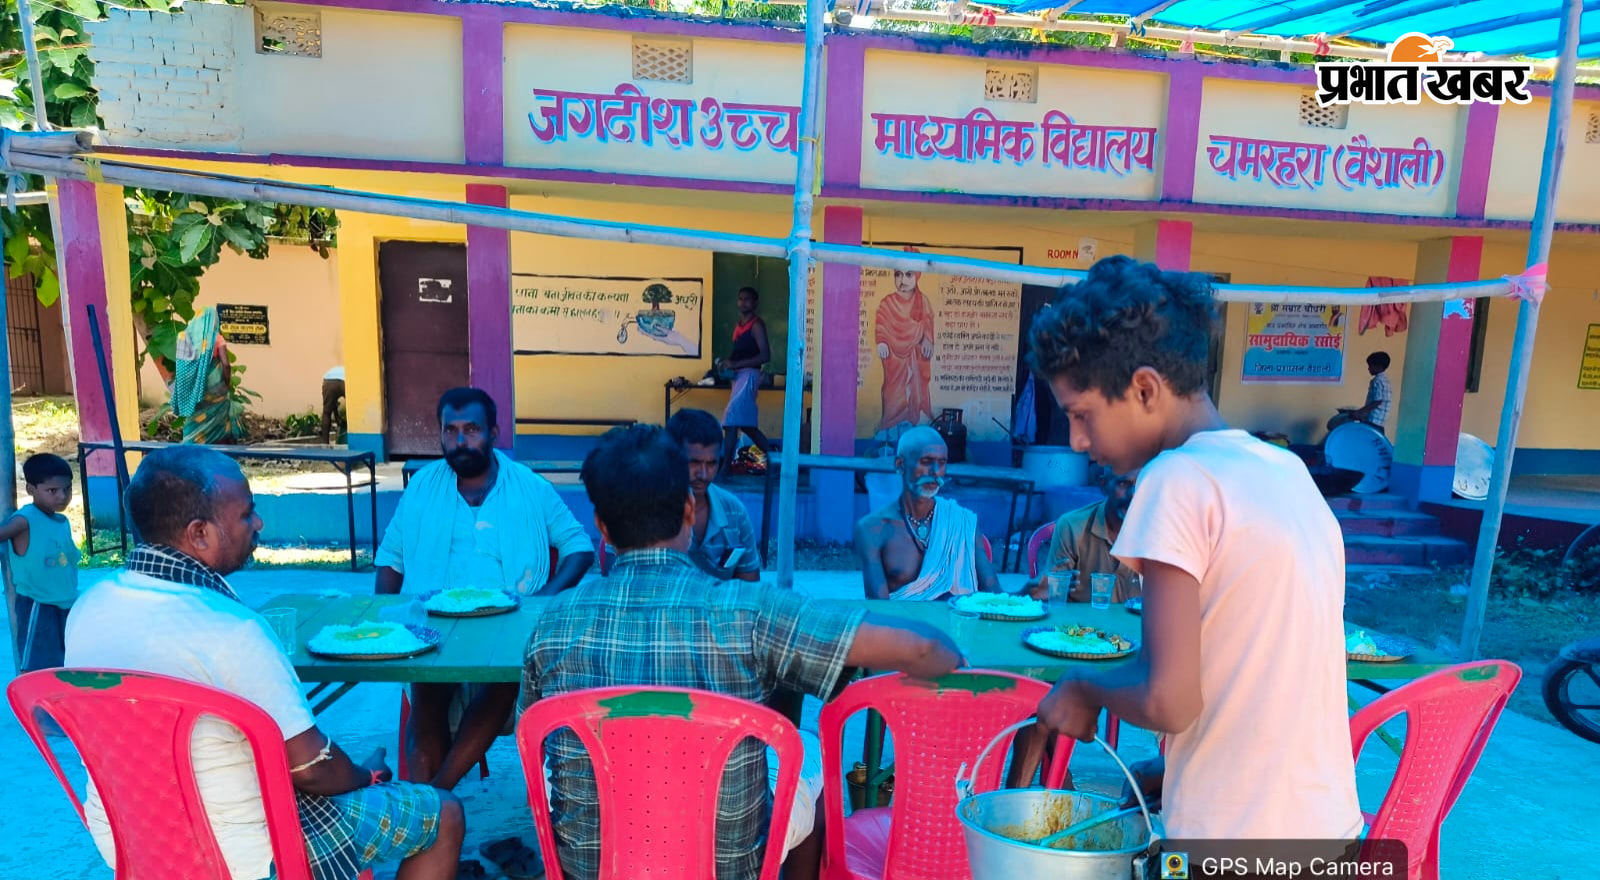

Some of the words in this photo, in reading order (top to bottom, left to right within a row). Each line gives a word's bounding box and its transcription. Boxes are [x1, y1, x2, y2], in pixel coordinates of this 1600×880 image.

[529, 83, 697, 147] जगदीश
[700, 97, 801, 152] उच्च
[871, 107, 1036, 165] माध्यमिक
[1040, 109, 1158, 176] विद्यालय
[1206, 134, 1329, 190] चमरहरा
[1331, 133, 1445, 190] (वैशाली)
[1047, 249, 1072, 259] ROOM
[1249, 332, 1311, 351] सामुदायिक
[1313, 332, 1343, 349] रसोई
